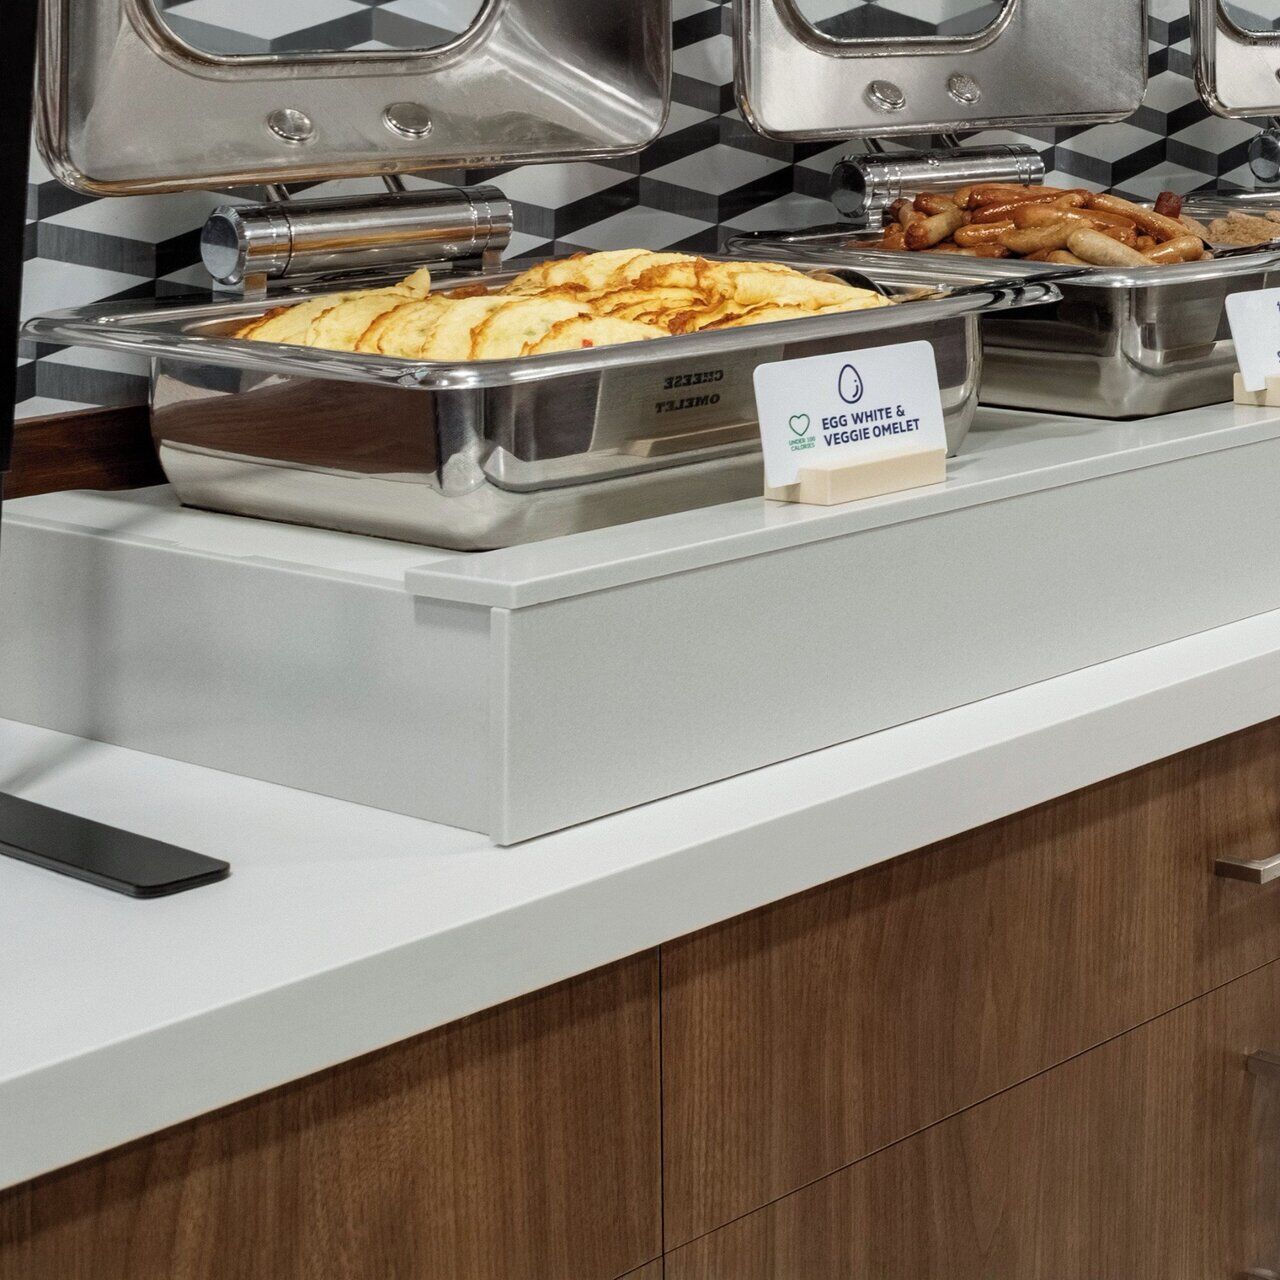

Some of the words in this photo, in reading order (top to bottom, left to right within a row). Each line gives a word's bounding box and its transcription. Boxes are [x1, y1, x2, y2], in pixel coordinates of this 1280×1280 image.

[821, 414, 848, 430] EGG
[850, 406, 893, 425] WHITE
[895, 404, 906, 417] &
[824, 428, 870, 447] VEGGIE
[873, 418, 920, 437] OMELET
